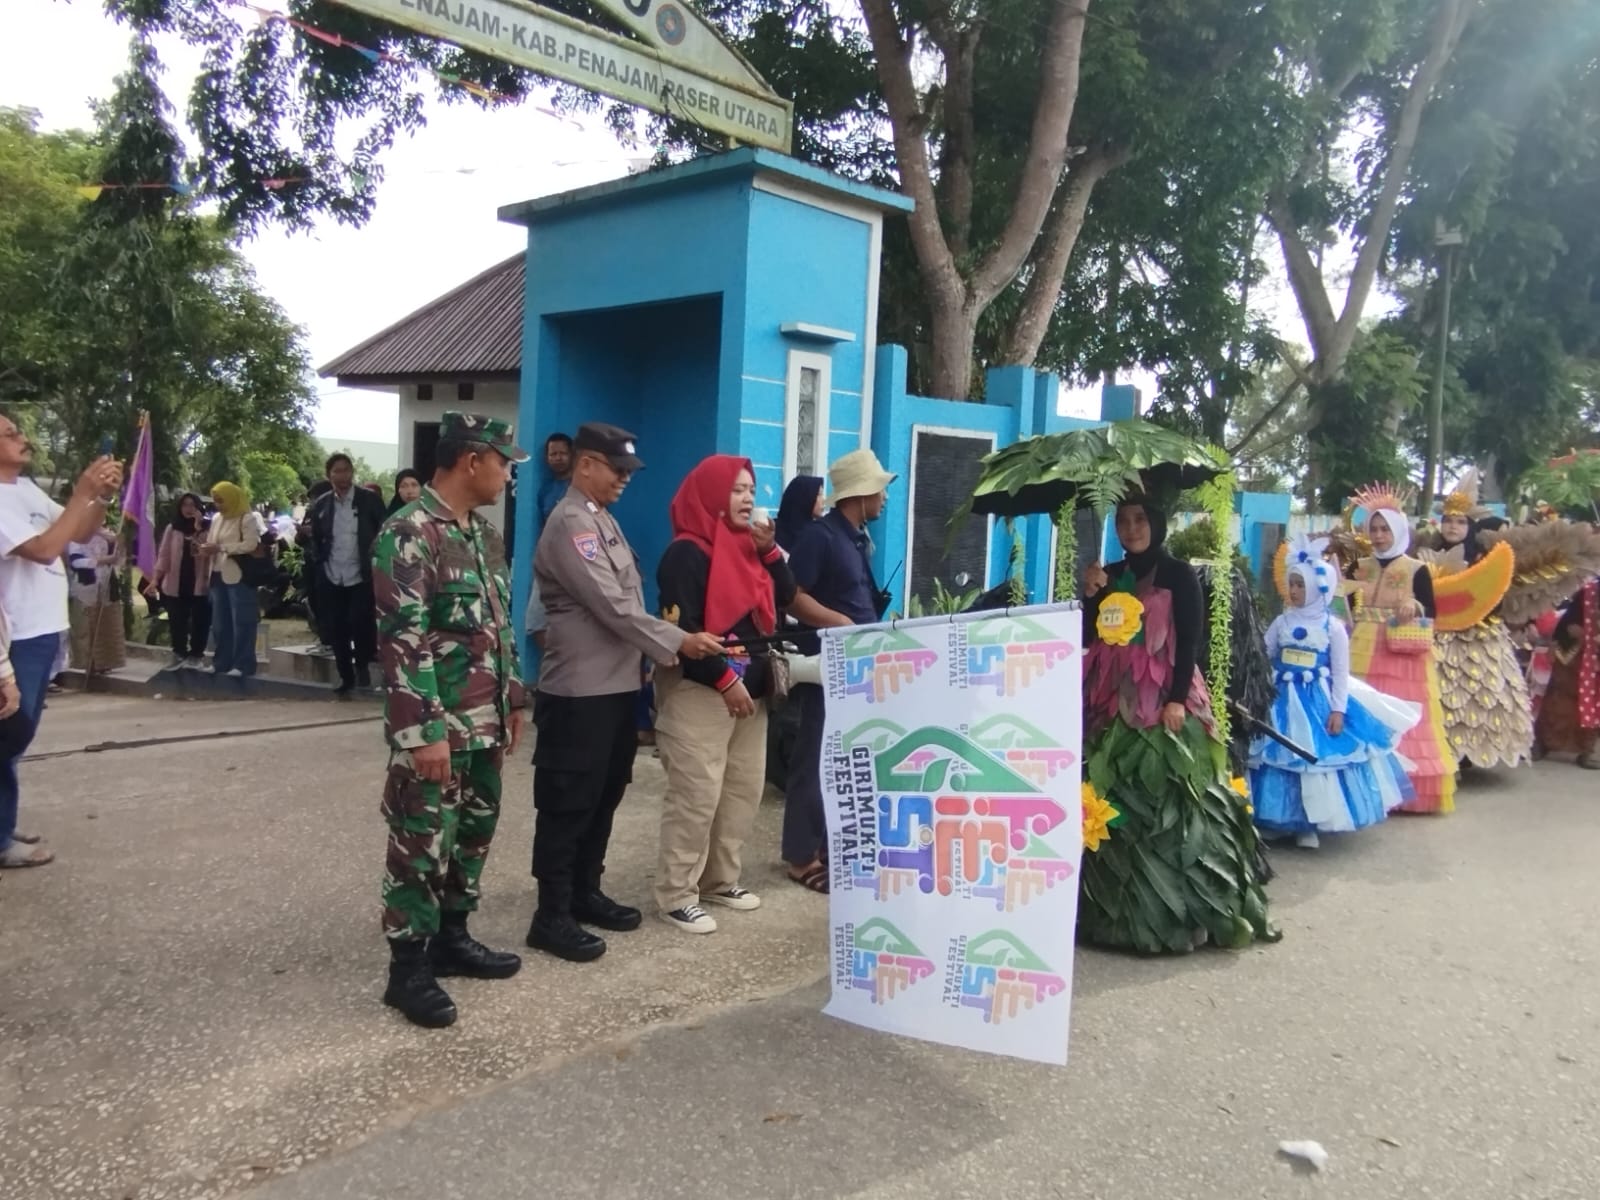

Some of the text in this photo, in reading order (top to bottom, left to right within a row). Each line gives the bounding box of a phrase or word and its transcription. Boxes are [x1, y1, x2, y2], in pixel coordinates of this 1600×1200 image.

[665, 78, 719, 115] PASER
[724, 103, 779, 137] UTARA
[826, 640, 837, 698] FESTIVAL
[948, 624, 957, 686] FESTIVAL
[824, 735, 835, 793] FESTIVAL
[833, 755, 859, 866] FESTIVAL
[851, 746, 876, 872] GIRIMUKTI
[833, 832, 843, 889] FESTIVAL
[835, 927, 845, 985] FESTIVAL
[844, 923, 854, 990] GIRIMUKTI
[942, 938, 958, 1003] FESTIVAL
[950, 935, 967, 1008] GIRIMUKTI
